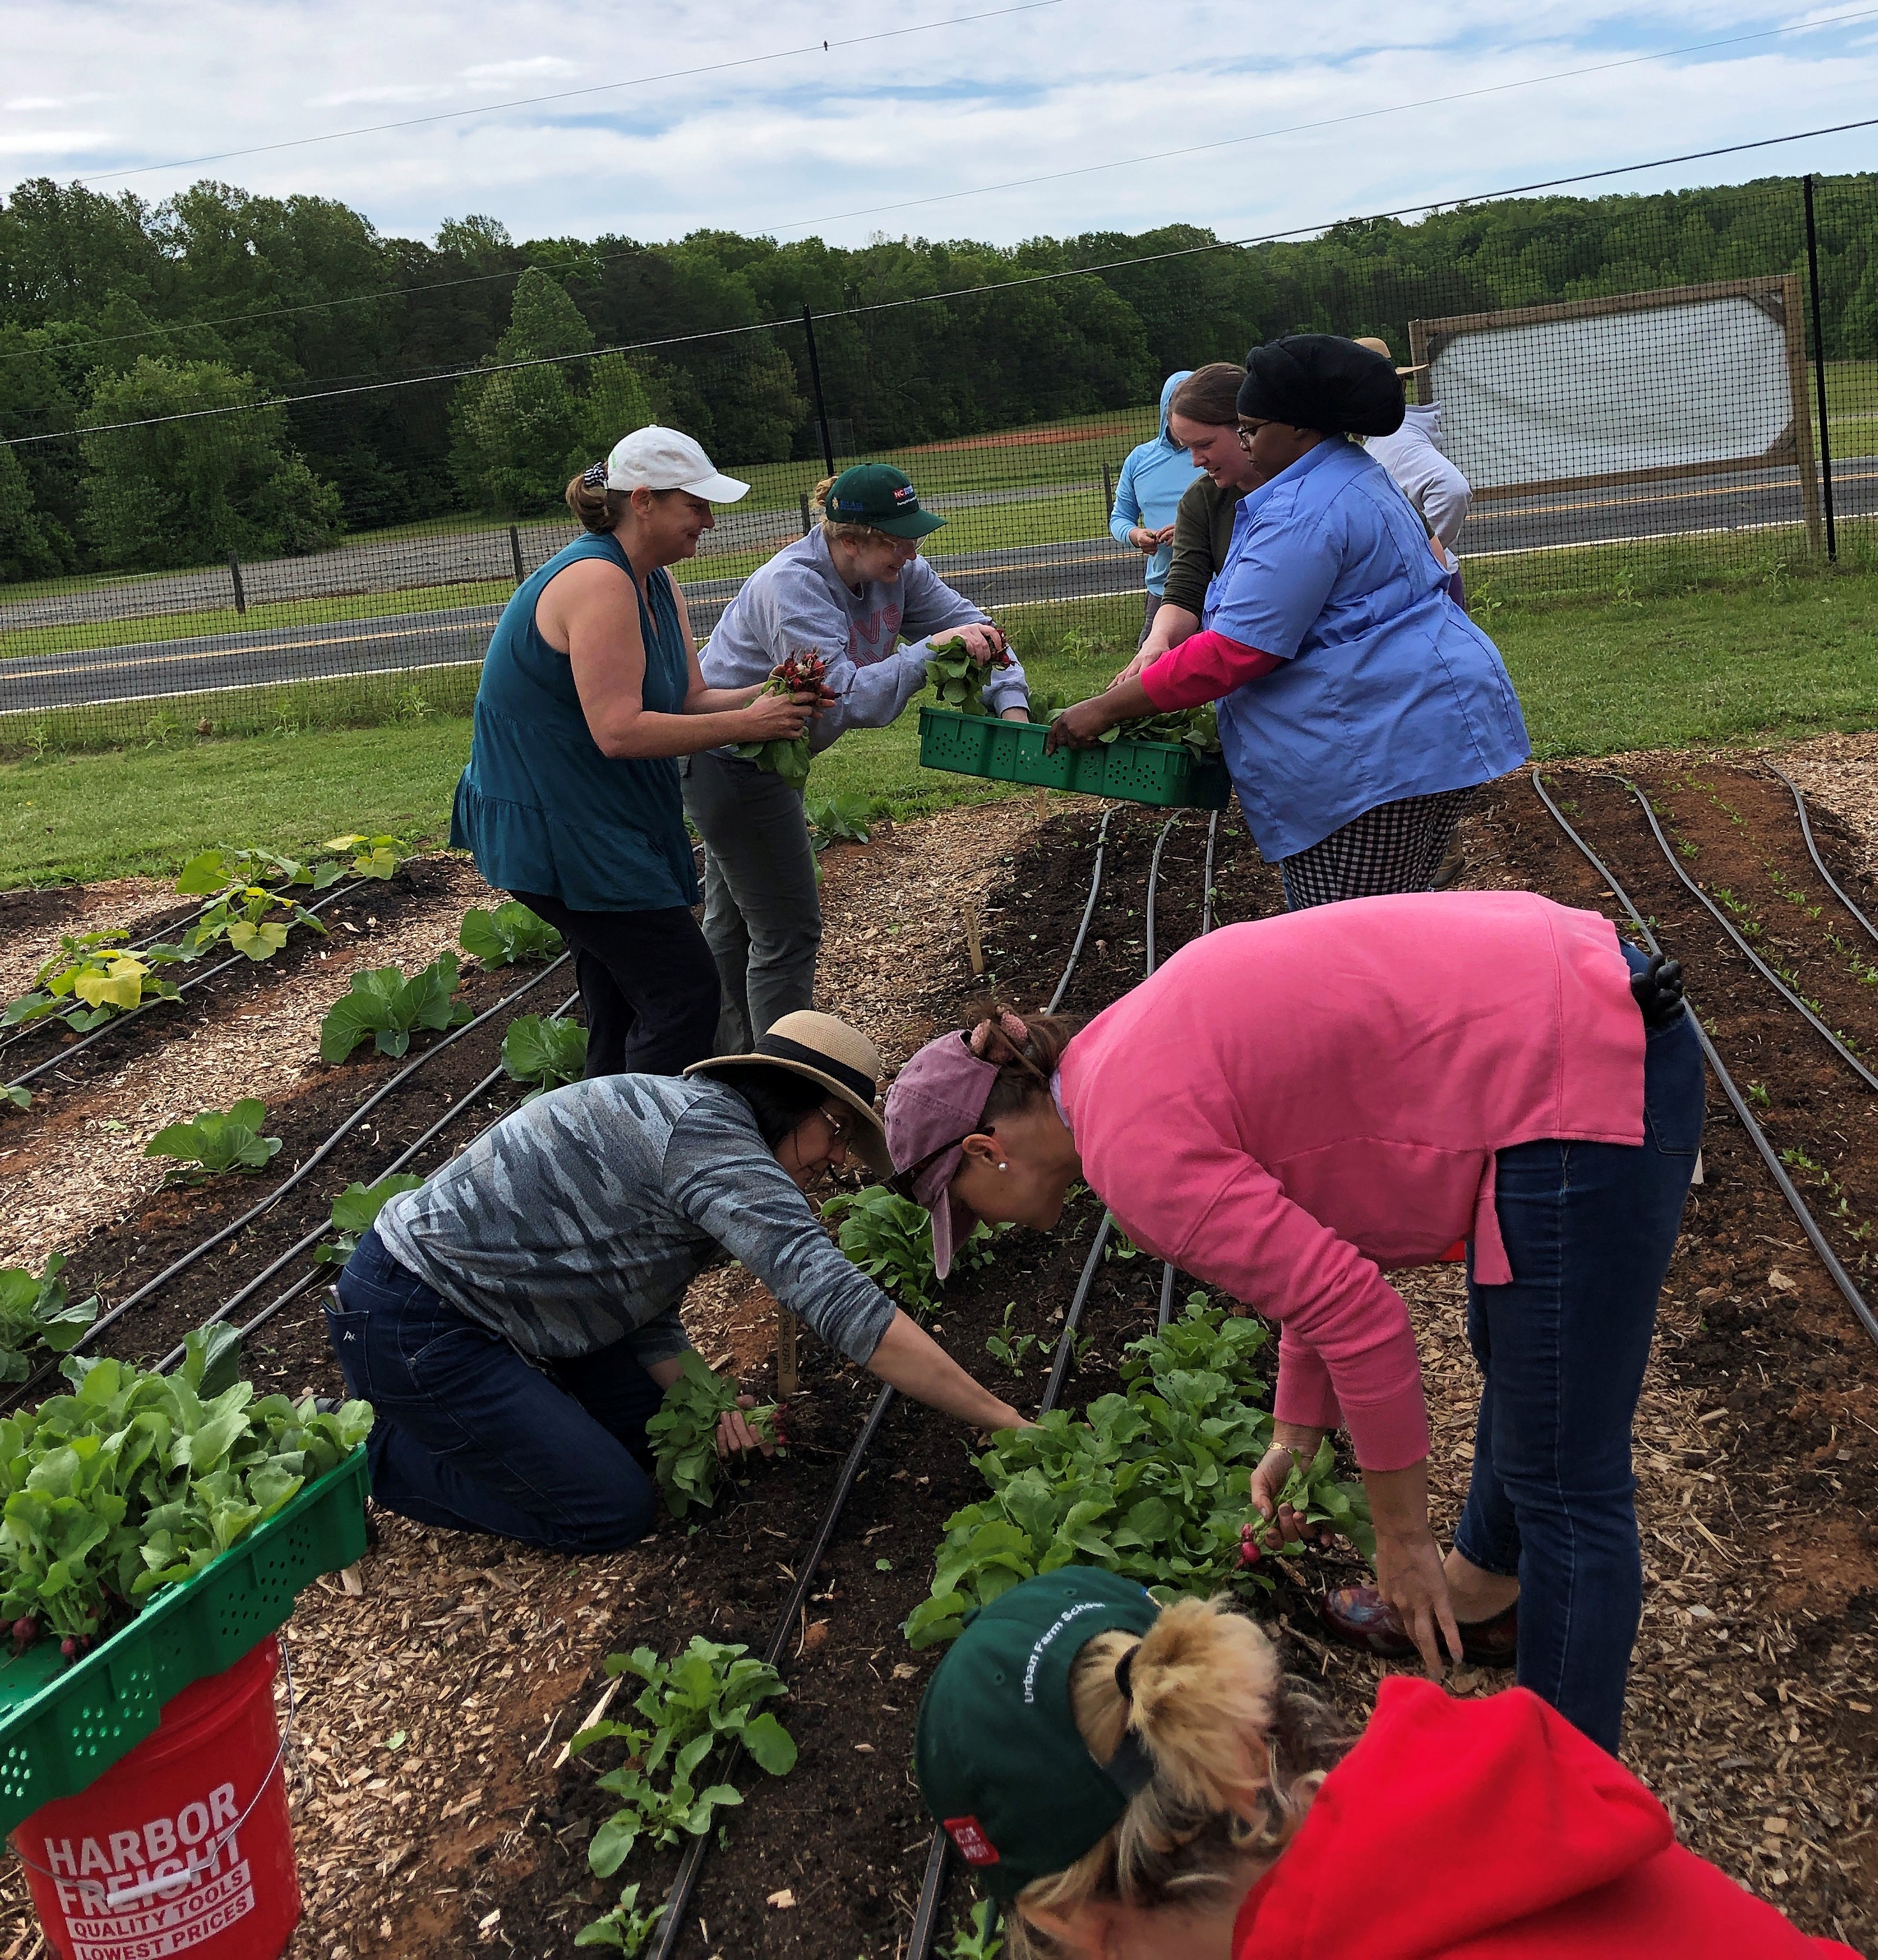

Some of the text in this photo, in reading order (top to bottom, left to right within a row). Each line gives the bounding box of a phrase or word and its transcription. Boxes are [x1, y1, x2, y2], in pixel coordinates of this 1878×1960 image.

[782, 1314, 792, 1341] PINK
[1023, 1654, 1039, 1703] Urban
[1033, 1621, 1063, 1652] Farm
[44, 1783, 239, 1876] HARBOR
[54, 1818, 243, 1916] FREIGHT
[74, 1869, 243, 1938] QUALITY TOOLS
[80, 1895, 248, 1960] LOWEST PRICES
